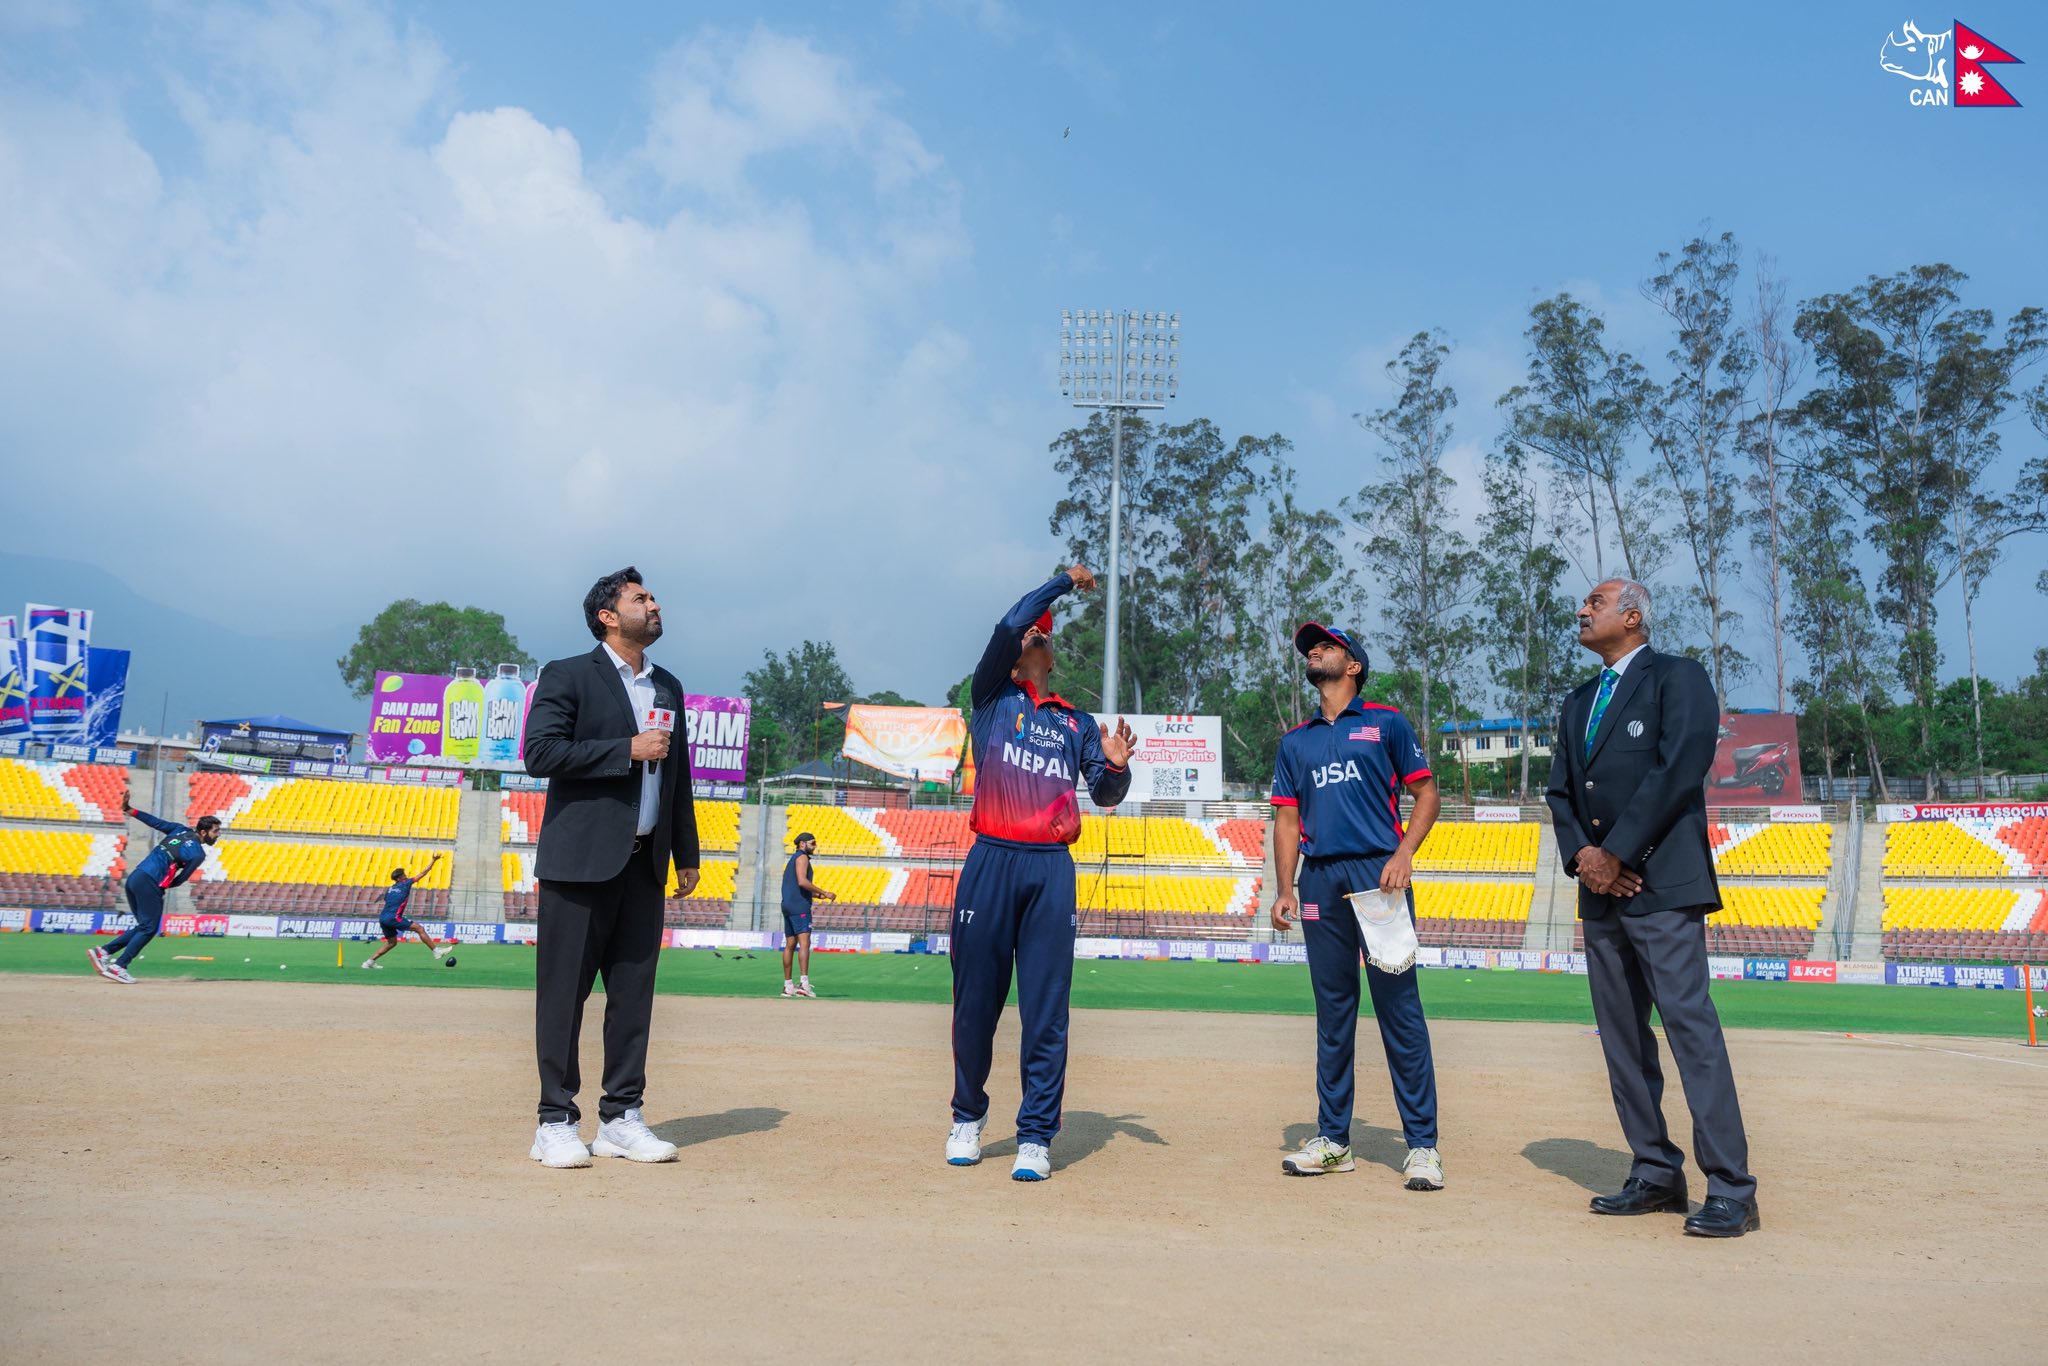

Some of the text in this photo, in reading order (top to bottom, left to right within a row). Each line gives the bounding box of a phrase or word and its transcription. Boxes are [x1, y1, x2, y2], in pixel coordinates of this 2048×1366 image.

[0, 706, 26, 720] EME
[381, 702, 408, 716] BAM
[410, 702, 438, 717] BAM
[453, 700, 479, 719] BAM
[491, 698, 519, 719] BAM
[373, 716, 441, 734] Fan Zone
[686, 709, 746, 747] BAM
[1165, 724, 1193, 733] KFC
[694, 747, 744, 770] DRINK
[1003, 742, 1071, 780] NEPAL
[1136, 749, 1216, 764] Loyalty Points
[1312, 760, 1362, 788] USA
[1921, 805, 2048, 819] CRICKET ASSOCIAT
[43, 912, 94, 924] XTREME
[960, 909, 974, 924] 17
[165, 919, 195, 927] JUICE
[280, 920, 335, 934] BAM BAM!
[341, 922, 383, 934] BAM BA
[454, 924, 496, 935] XTREME
[826, 934, 863, 945] XTREME
[1132, 941, 1159, 949] NAASA
[1170, 942, 1207, 953] XTREME
[1215, 943, 1252, 954] XTREME
[1269, 945, 1306, 956] XTREME
[1446, 950, 1463, 960] MAX
[1467, 951, 1486, 961] TIGER
[1501, 951, 1540, 963] MAX TIGER
[1550, 953, 1587, 965] MAX TIGE
[1711, 964, 1742, 973] MetLife
[1756, 962, 1786, 971] NAASA
[1804, 966, 1834, 977] KFC
[1896, 966, 1944, 978] XTREME
[1756, 970, 1786, 978] SECURITIES
[1954, 967, 2004, 980] XTREME
[1897, 977, 1922, 985] ENERGY
[2019, 979, 2047, 988] EERGY
